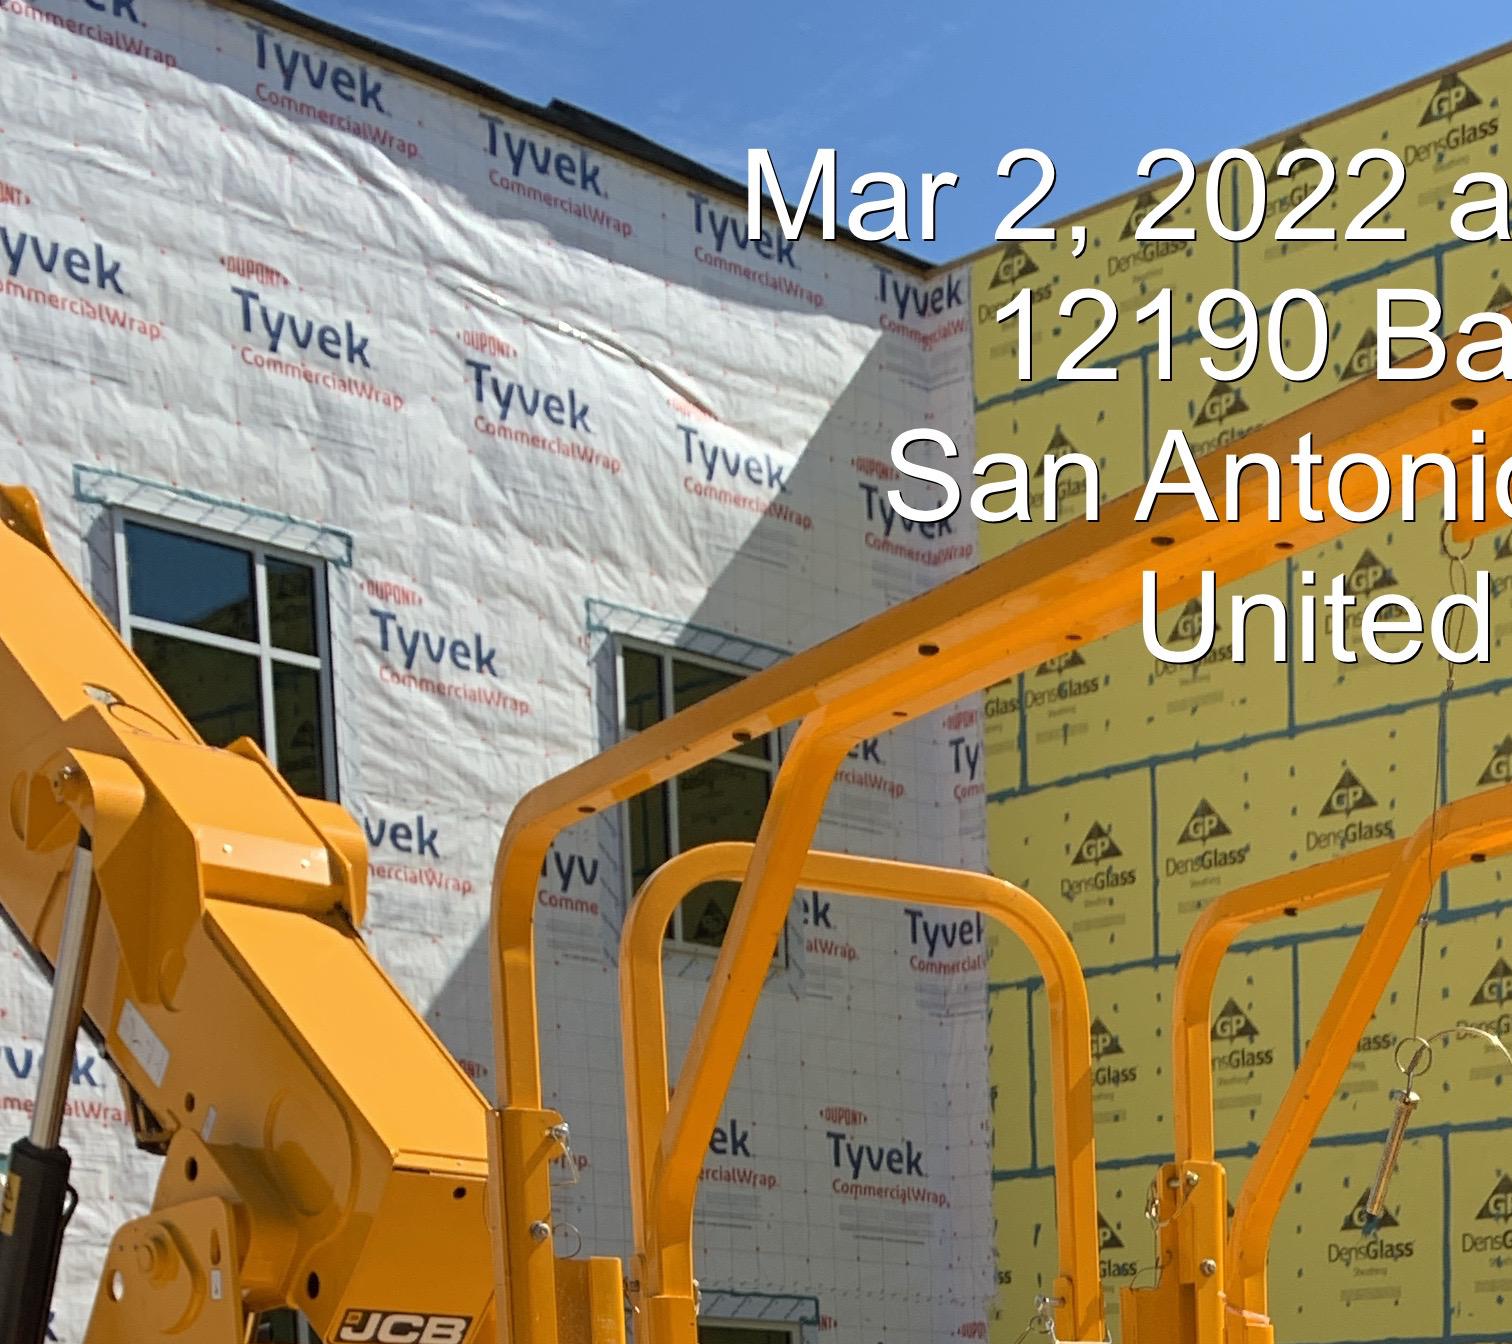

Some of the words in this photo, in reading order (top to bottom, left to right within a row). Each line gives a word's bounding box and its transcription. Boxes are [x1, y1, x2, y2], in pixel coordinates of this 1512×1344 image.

[247, 22, 386, 115] Tyvek
[256, 83, 420, 158] CommercialWrap
[1431, 84, 1468, 118] GP
[479, 112, 604, 198] Tyvek
[1403, 116, 1499, 167] DensGlass
[489, 168, 634, 238] CommercialWrap
[0, 225, 125, 296] yvek
[226, 257, 286, 284] DUPONT
[694, 245, 824, 307] CommercialWrap
[0, 278, 165, 340] ommercialWrap
[874, 264, 963, 322] Tyvek
[230, 285, 372, 368] Tyvek
[240, 345, 406, 412] CommercialWrap
[465, 358, 592, 433] Tyvek
[474, 415, 622, 475] CommercialWrap
[676, 424, 787, 493] Tyvek
[684, 476, 813, 530] CommercialWrap
[366, 578, 421, 607] DUPONT
[370, 607, 499, 678] Tyvek
[379, 664, 533, 716] CommercialWrap
[1329, 786, 1365, 809] GP
[1081, 839, 1112, 861] GP
[1187, 816, 1219, 838] GP
[1306, 820, 1393, 849] DensGlass
[1060, 866, 1137, 898] DensGlass
[1166, 847, 1247, 877] DensGlass
[1216, 1016, 1247, 1038] GP
[826, 1131, 925, 1179] Tyvek
[832, 1178, 947, 1206] CommercialWrap
[1328, 1240, 1414, 1264] DensGlass
